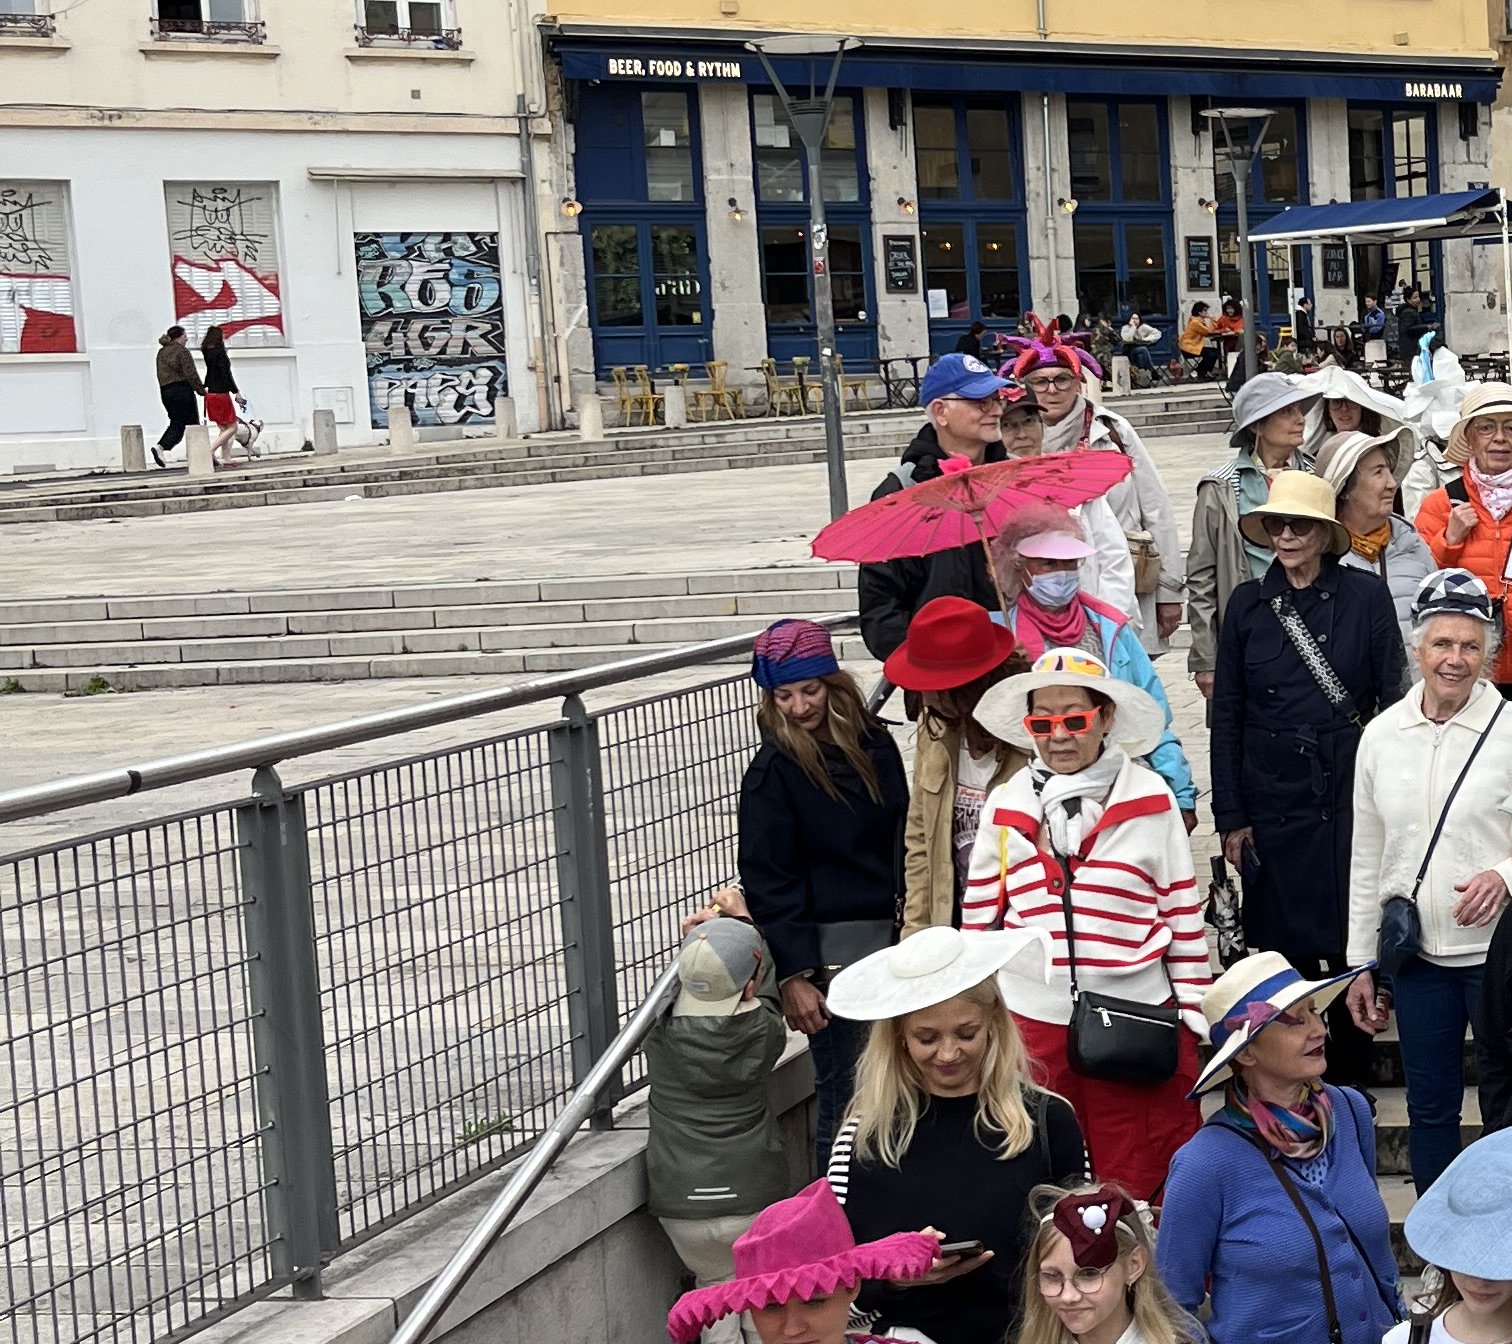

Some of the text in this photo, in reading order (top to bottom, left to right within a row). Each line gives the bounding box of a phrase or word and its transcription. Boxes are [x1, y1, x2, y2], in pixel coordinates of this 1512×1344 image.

[608, 58, 741, 78] BEER, FOOD & RYTHM
[1405, 82, 1463, 98] BARABAAR
